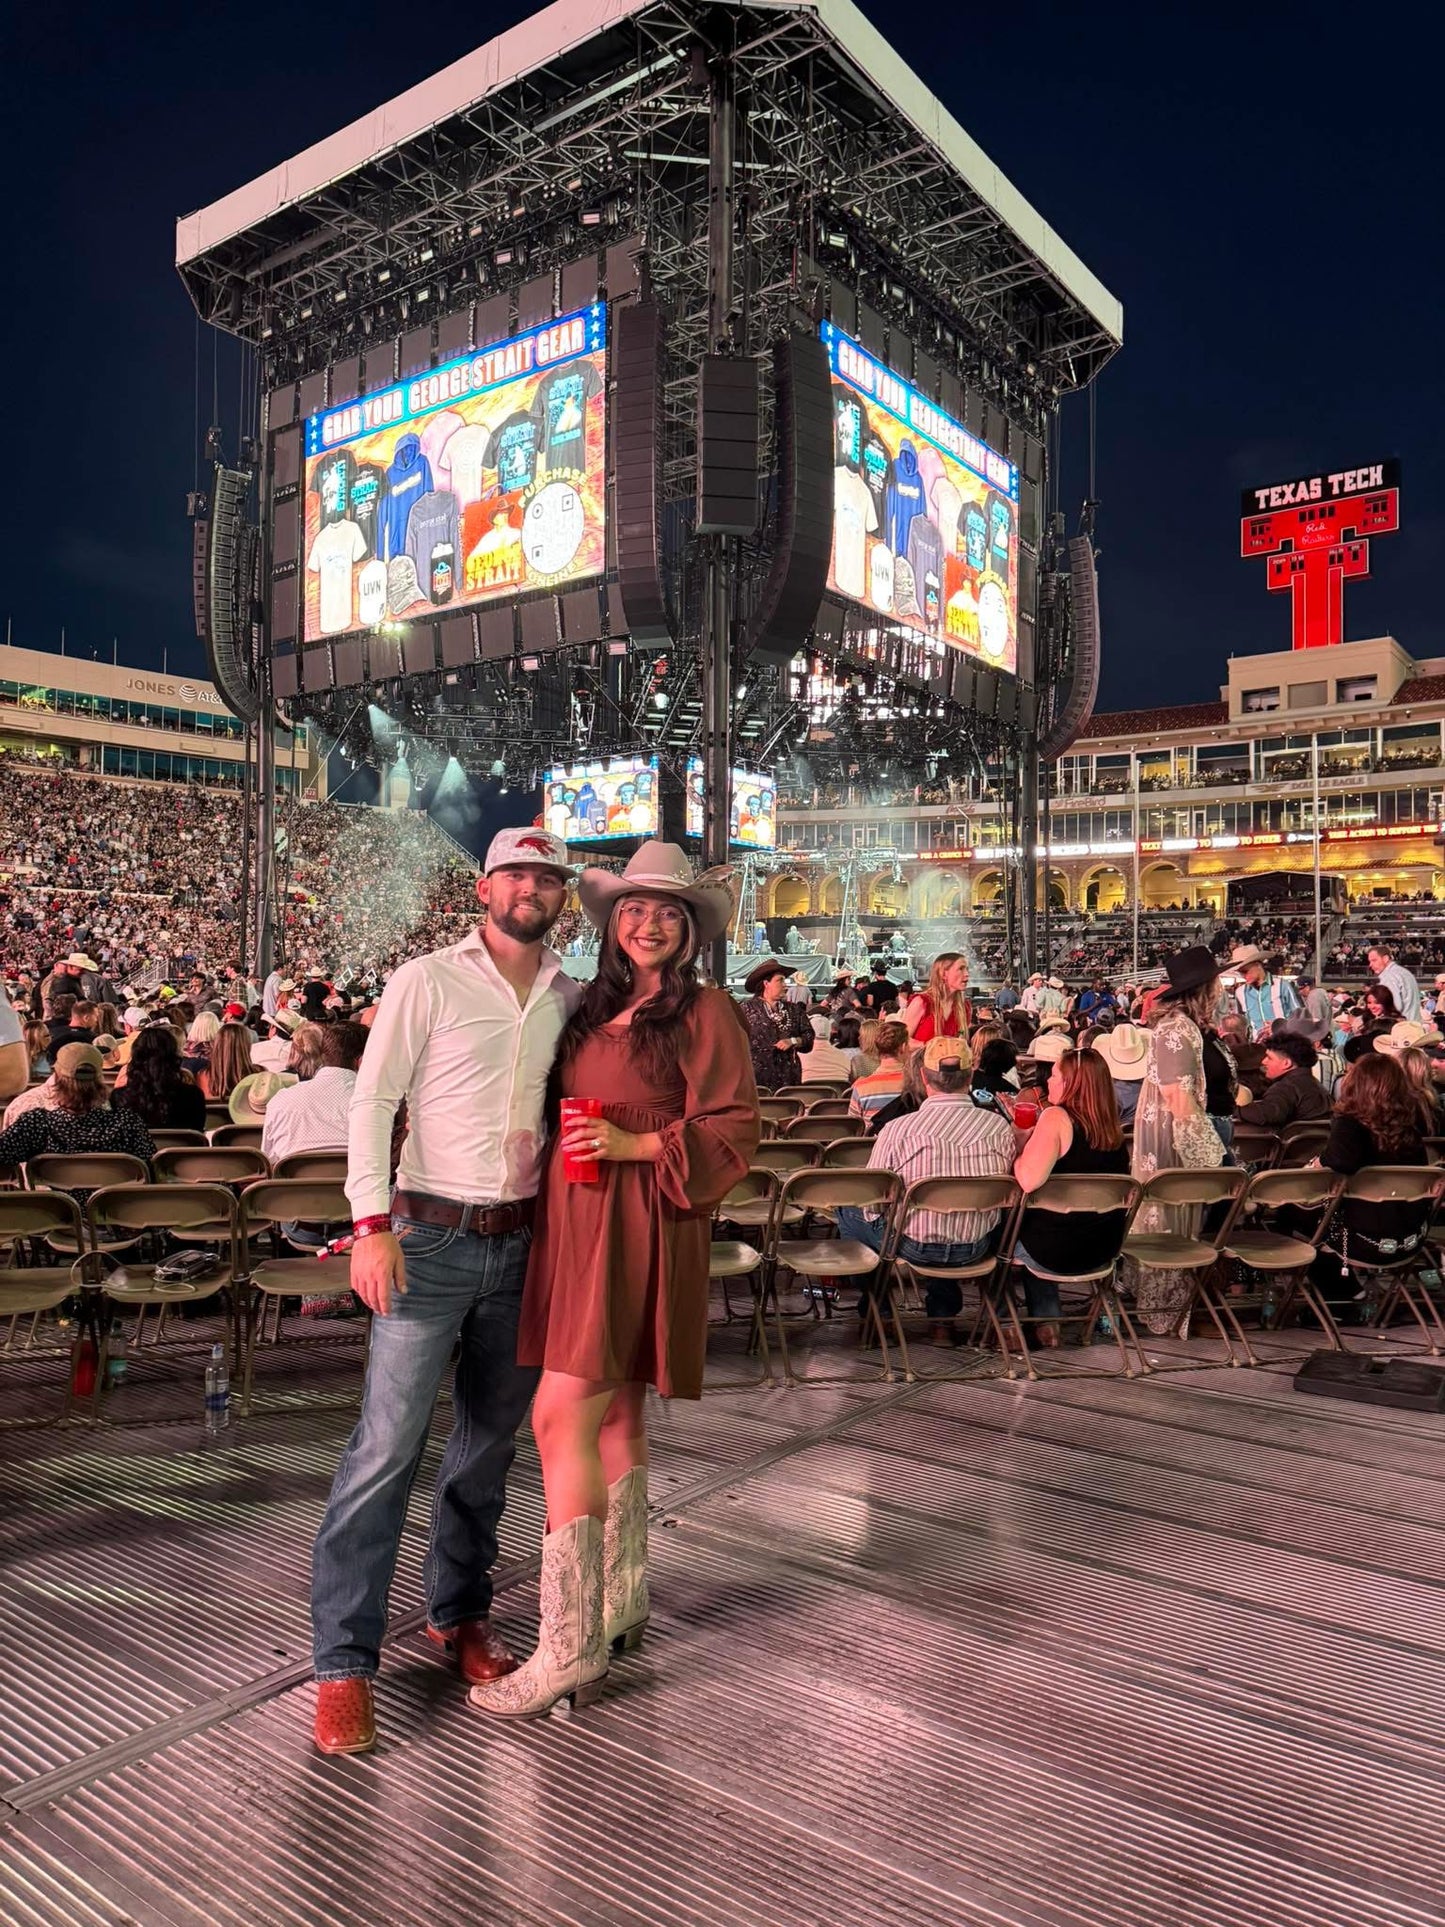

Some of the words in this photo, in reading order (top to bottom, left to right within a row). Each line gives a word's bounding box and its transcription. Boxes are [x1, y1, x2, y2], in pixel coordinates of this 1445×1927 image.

[364, 391, 403, 429] YOUR
[409, 363, 471, 412] GEORGE
[472, 339, 533, 388] STRAIT
[536, 319, 584, 365] GEAR
[518, 467, 588, 508] PURCHASE
[1255, 478, 1322, 510] TEXAS
[1327, 464, 1384, 495] TECH
[1306, 522, 1327, 533] Red
[126, 678, 175, 696] JONES
[197, 691, 223, 705] AT&
[1292, 780, 1330, 790] DOULE
[1376, 828, 1388, 836] TO
